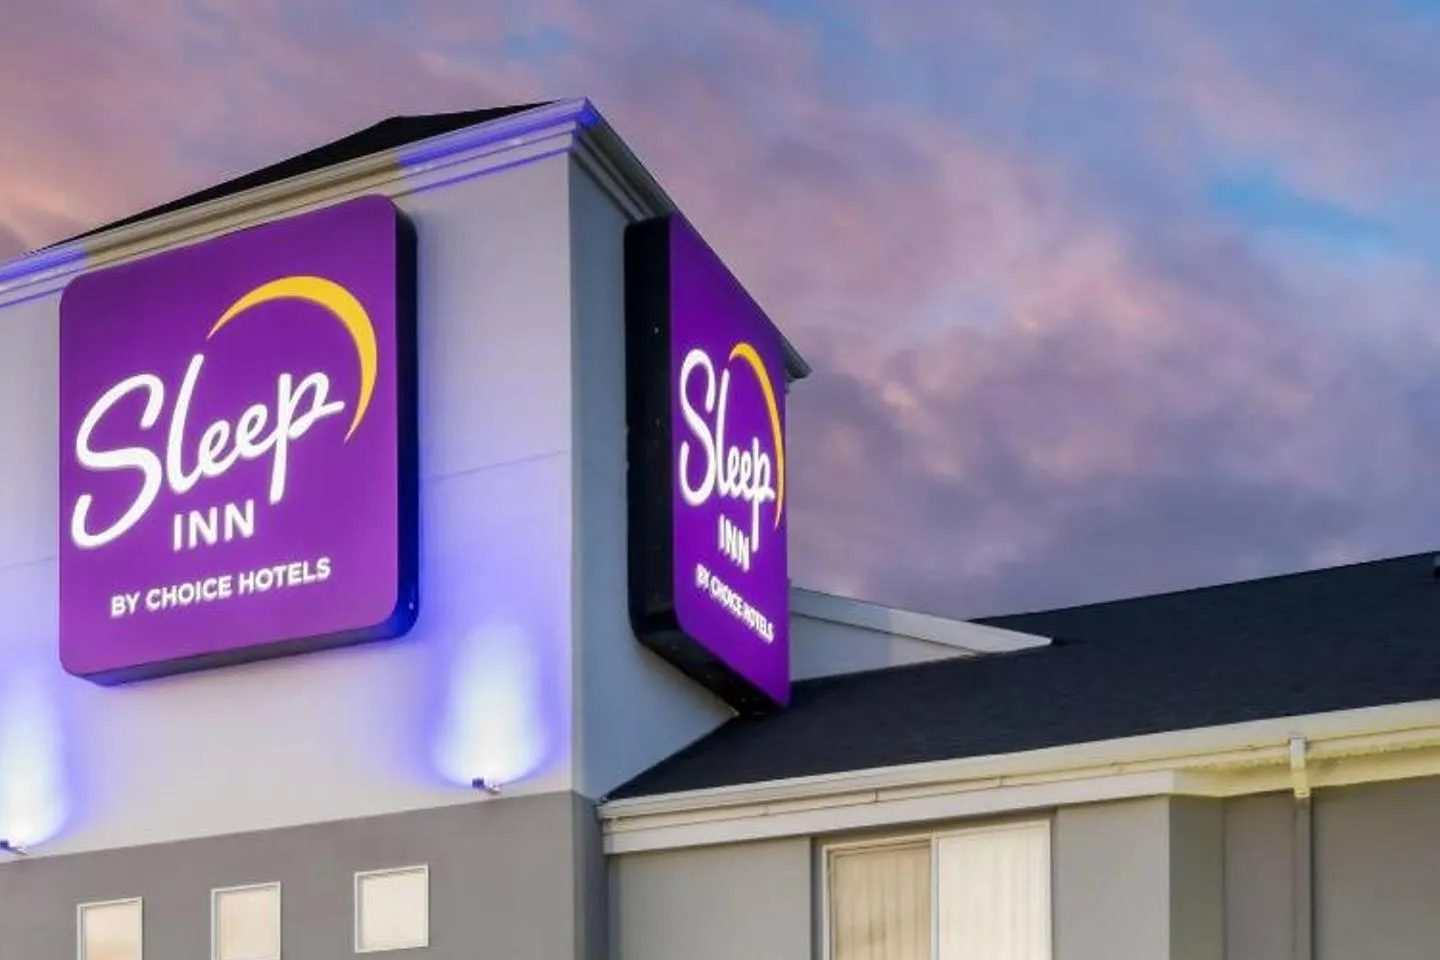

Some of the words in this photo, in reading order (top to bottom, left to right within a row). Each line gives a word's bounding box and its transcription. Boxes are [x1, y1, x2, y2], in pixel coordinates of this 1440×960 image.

[71, 353, 345, 548] Sleep
[679, 348, 776, 552] Sleep
[173, 498, 255, 552] INN
[718, 513, 750, 573] INN
[111, 591, 141, 617] BY
[145, 575, 233, 611] CHOICE
[238, 556, 331, 595] HOTELS
